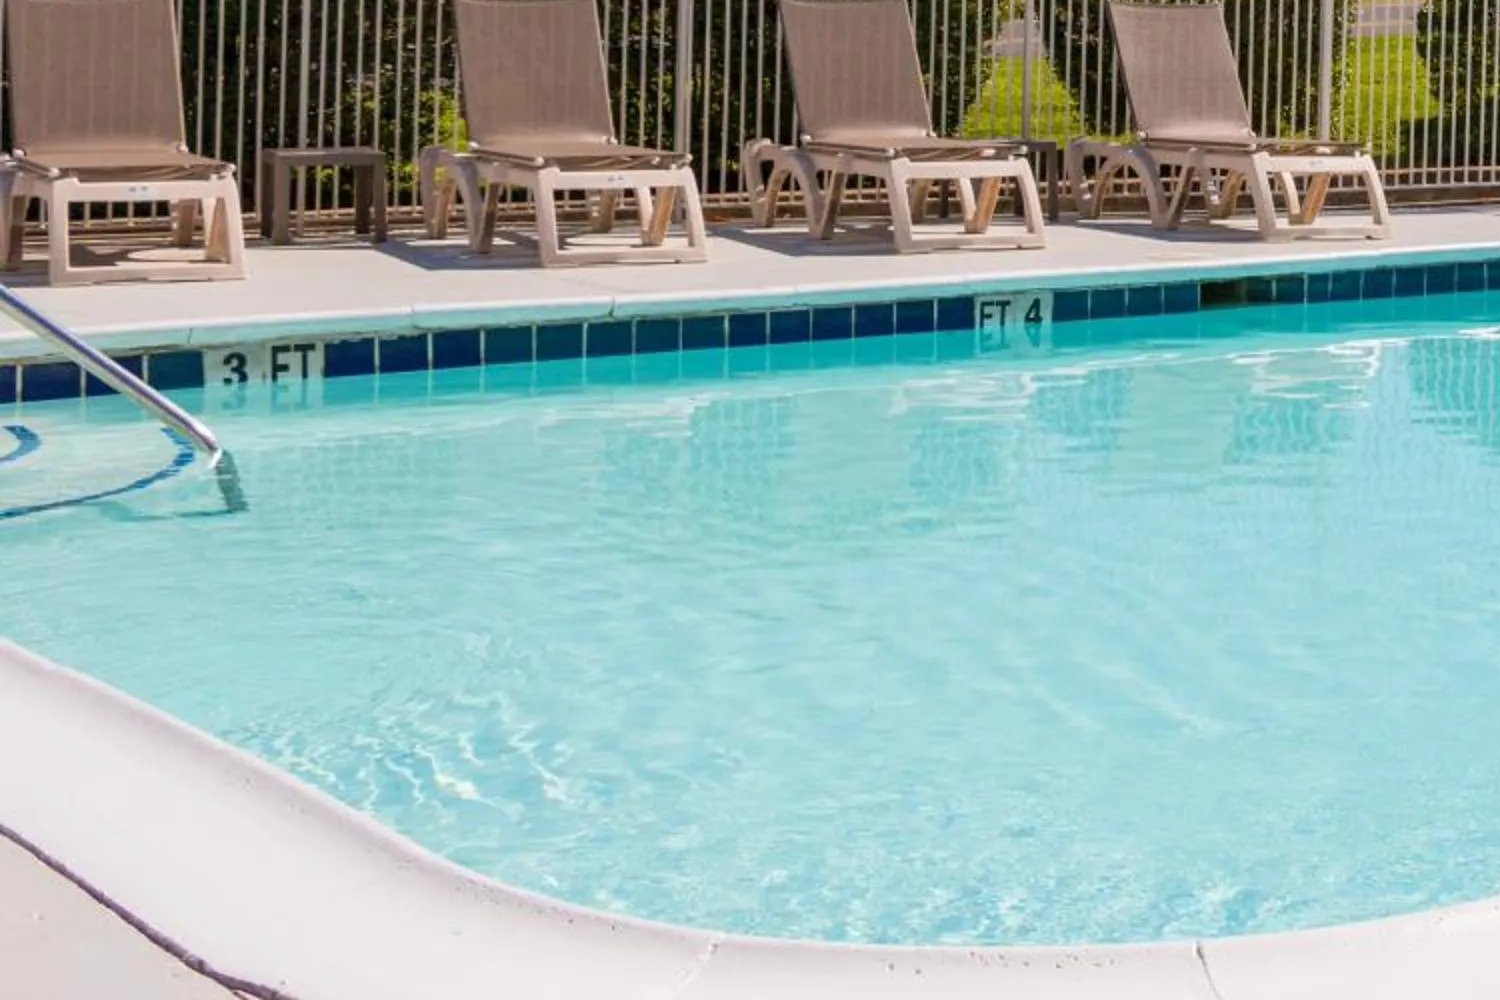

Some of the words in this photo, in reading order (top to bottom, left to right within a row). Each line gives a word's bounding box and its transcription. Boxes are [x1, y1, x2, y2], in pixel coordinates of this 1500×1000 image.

[980, 300, 1011, 329] FT
[1024, 296, 1043, 324] 4
[223, 351, 248, 386] 3
[271, 343, 316, 382] FT
